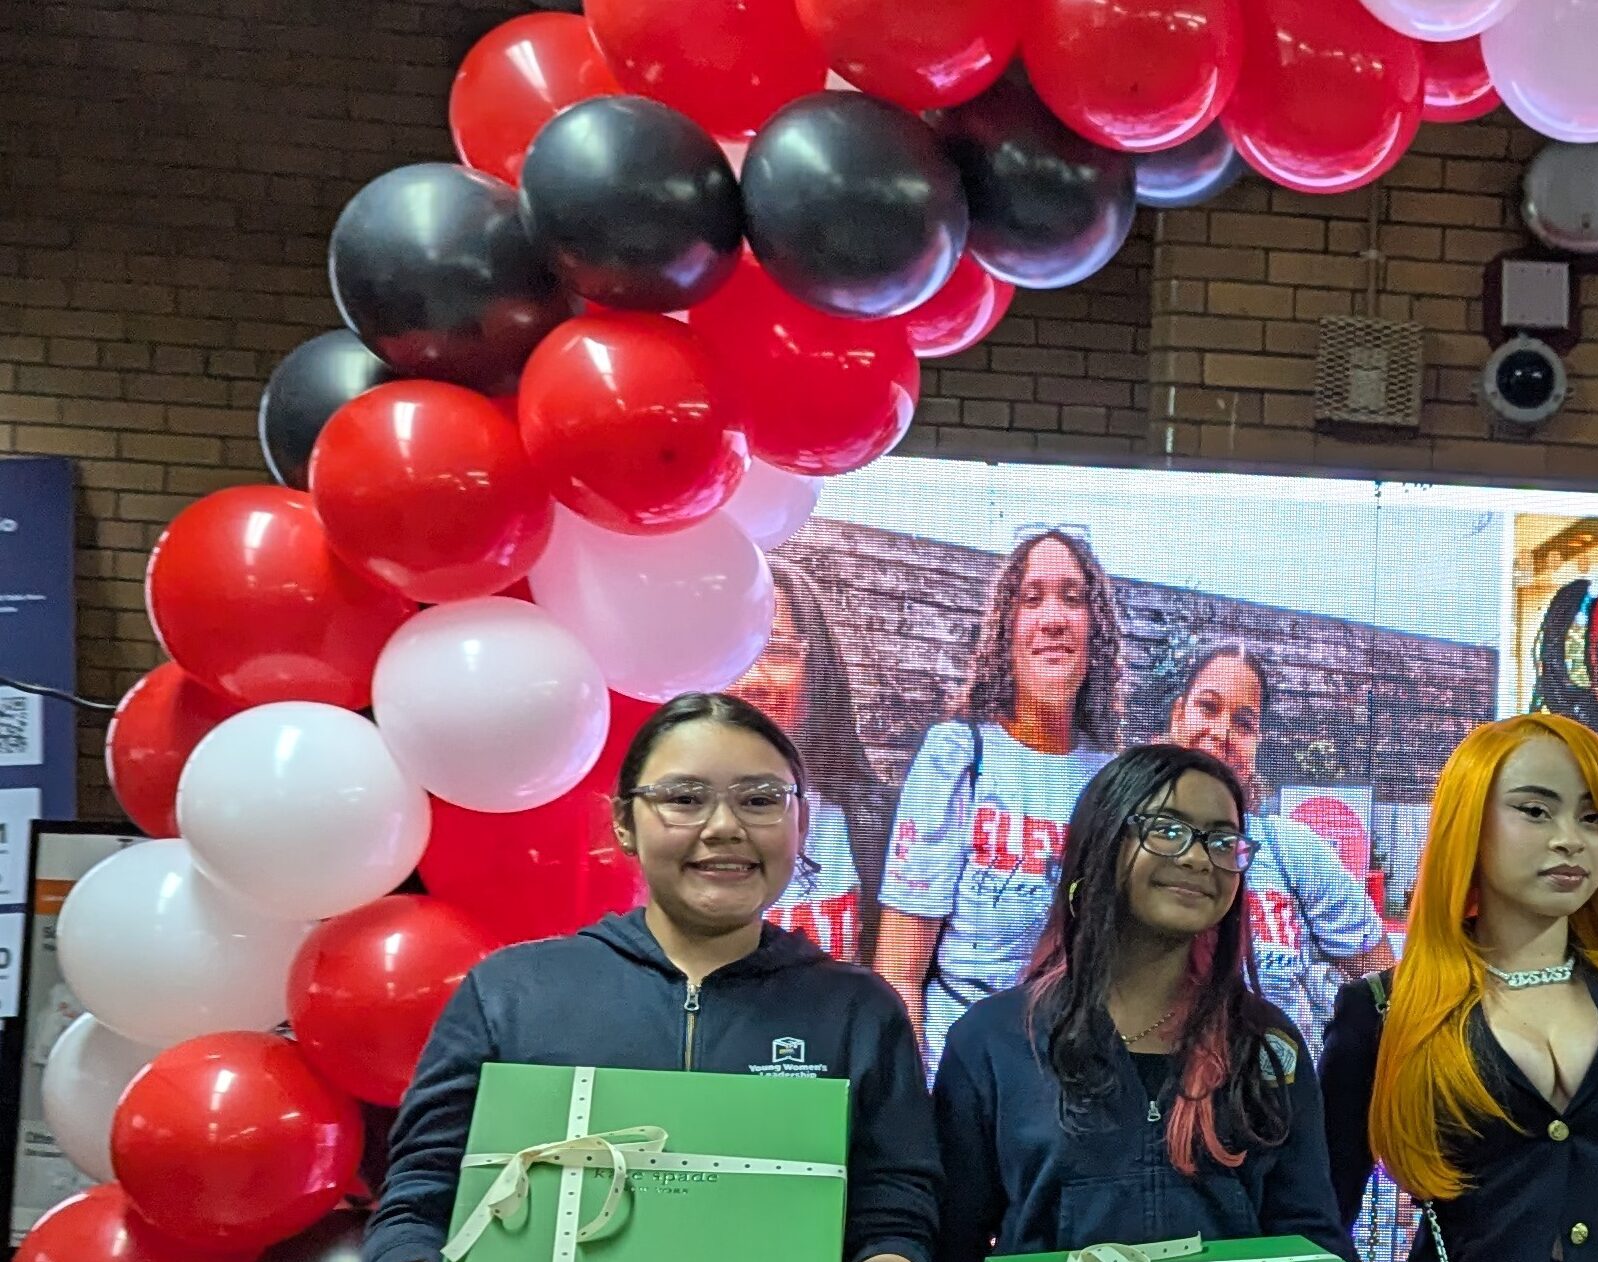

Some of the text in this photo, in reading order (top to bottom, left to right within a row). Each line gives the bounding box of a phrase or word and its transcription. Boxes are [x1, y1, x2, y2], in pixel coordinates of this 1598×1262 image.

[748, 1063, 828, 1072] Young Women's
[594, 1168, 719, 1186] ke spade
